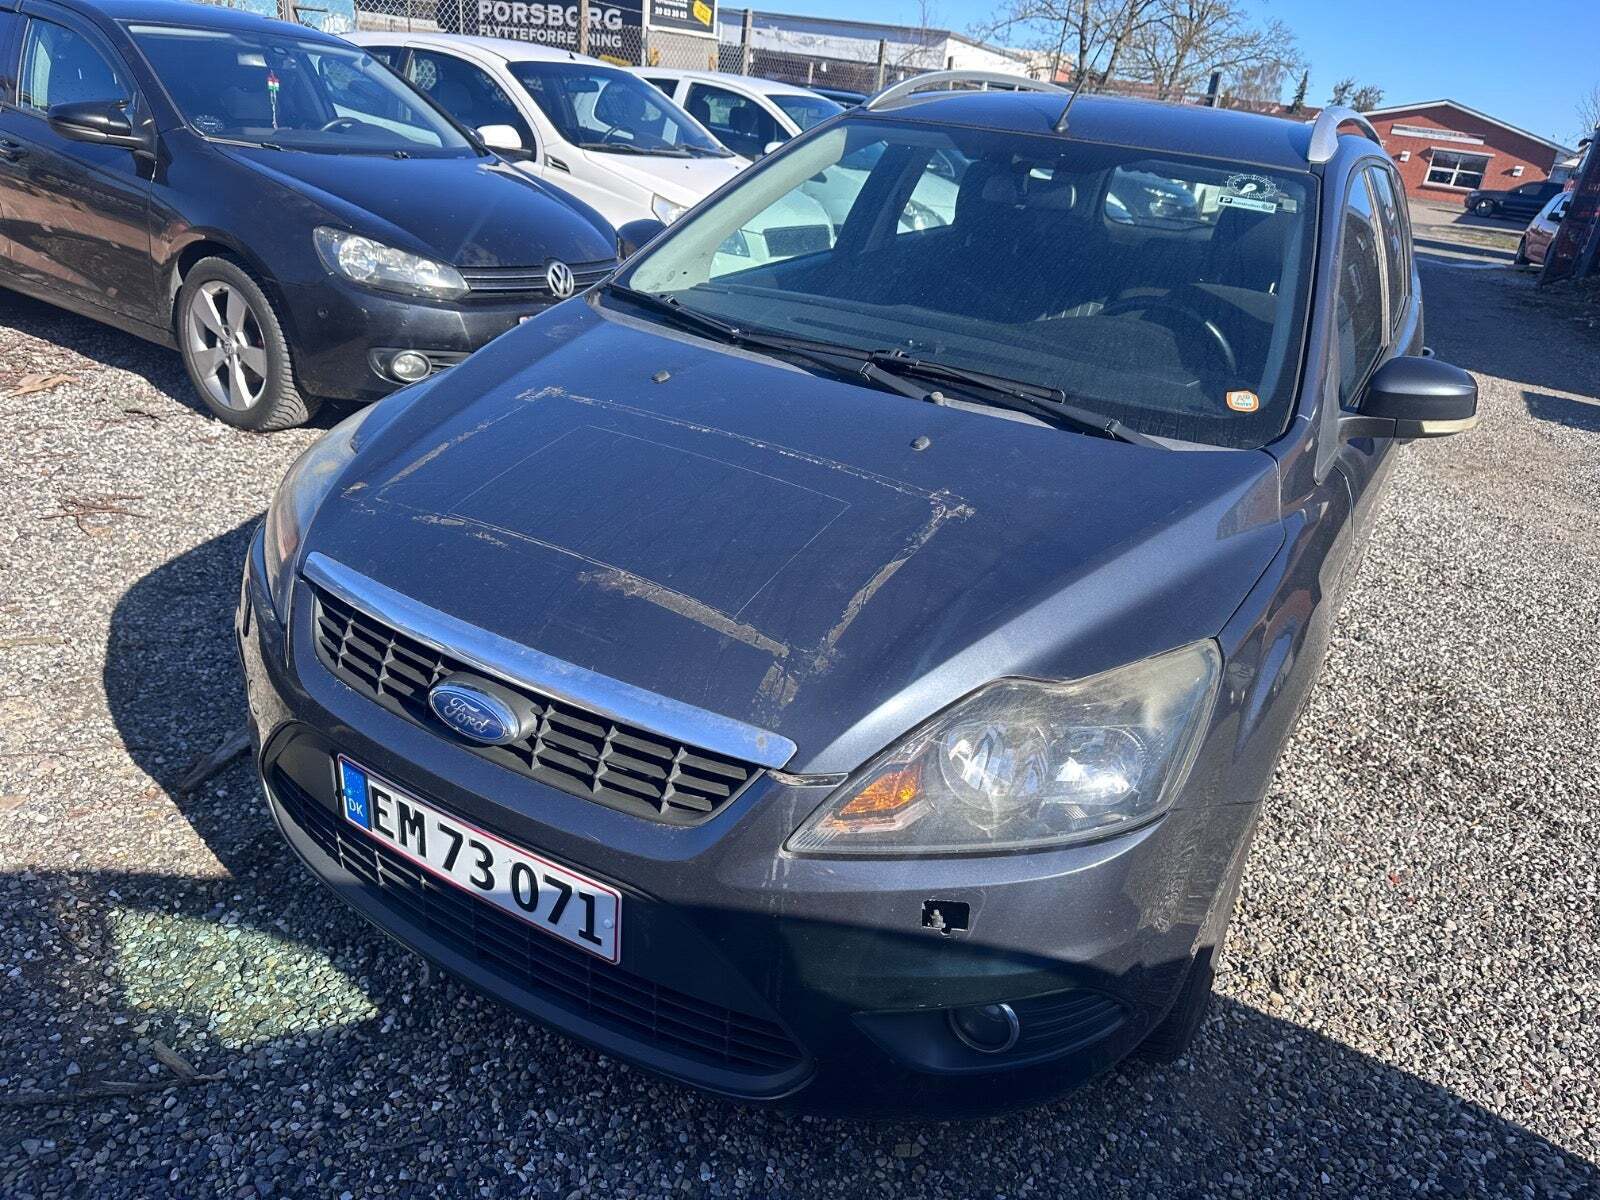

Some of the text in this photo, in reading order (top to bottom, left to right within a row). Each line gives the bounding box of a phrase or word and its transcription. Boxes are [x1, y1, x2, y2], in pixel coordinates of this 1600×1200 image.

[478, 0, 623, 30] PORSBORG
[478, 24, 622, 48] FLYTTEFORRENING
[444, 697, 490, 733] Ford
[348, 795, 364, 818] DK
[370, 785, 602, 946] EM 73 071
